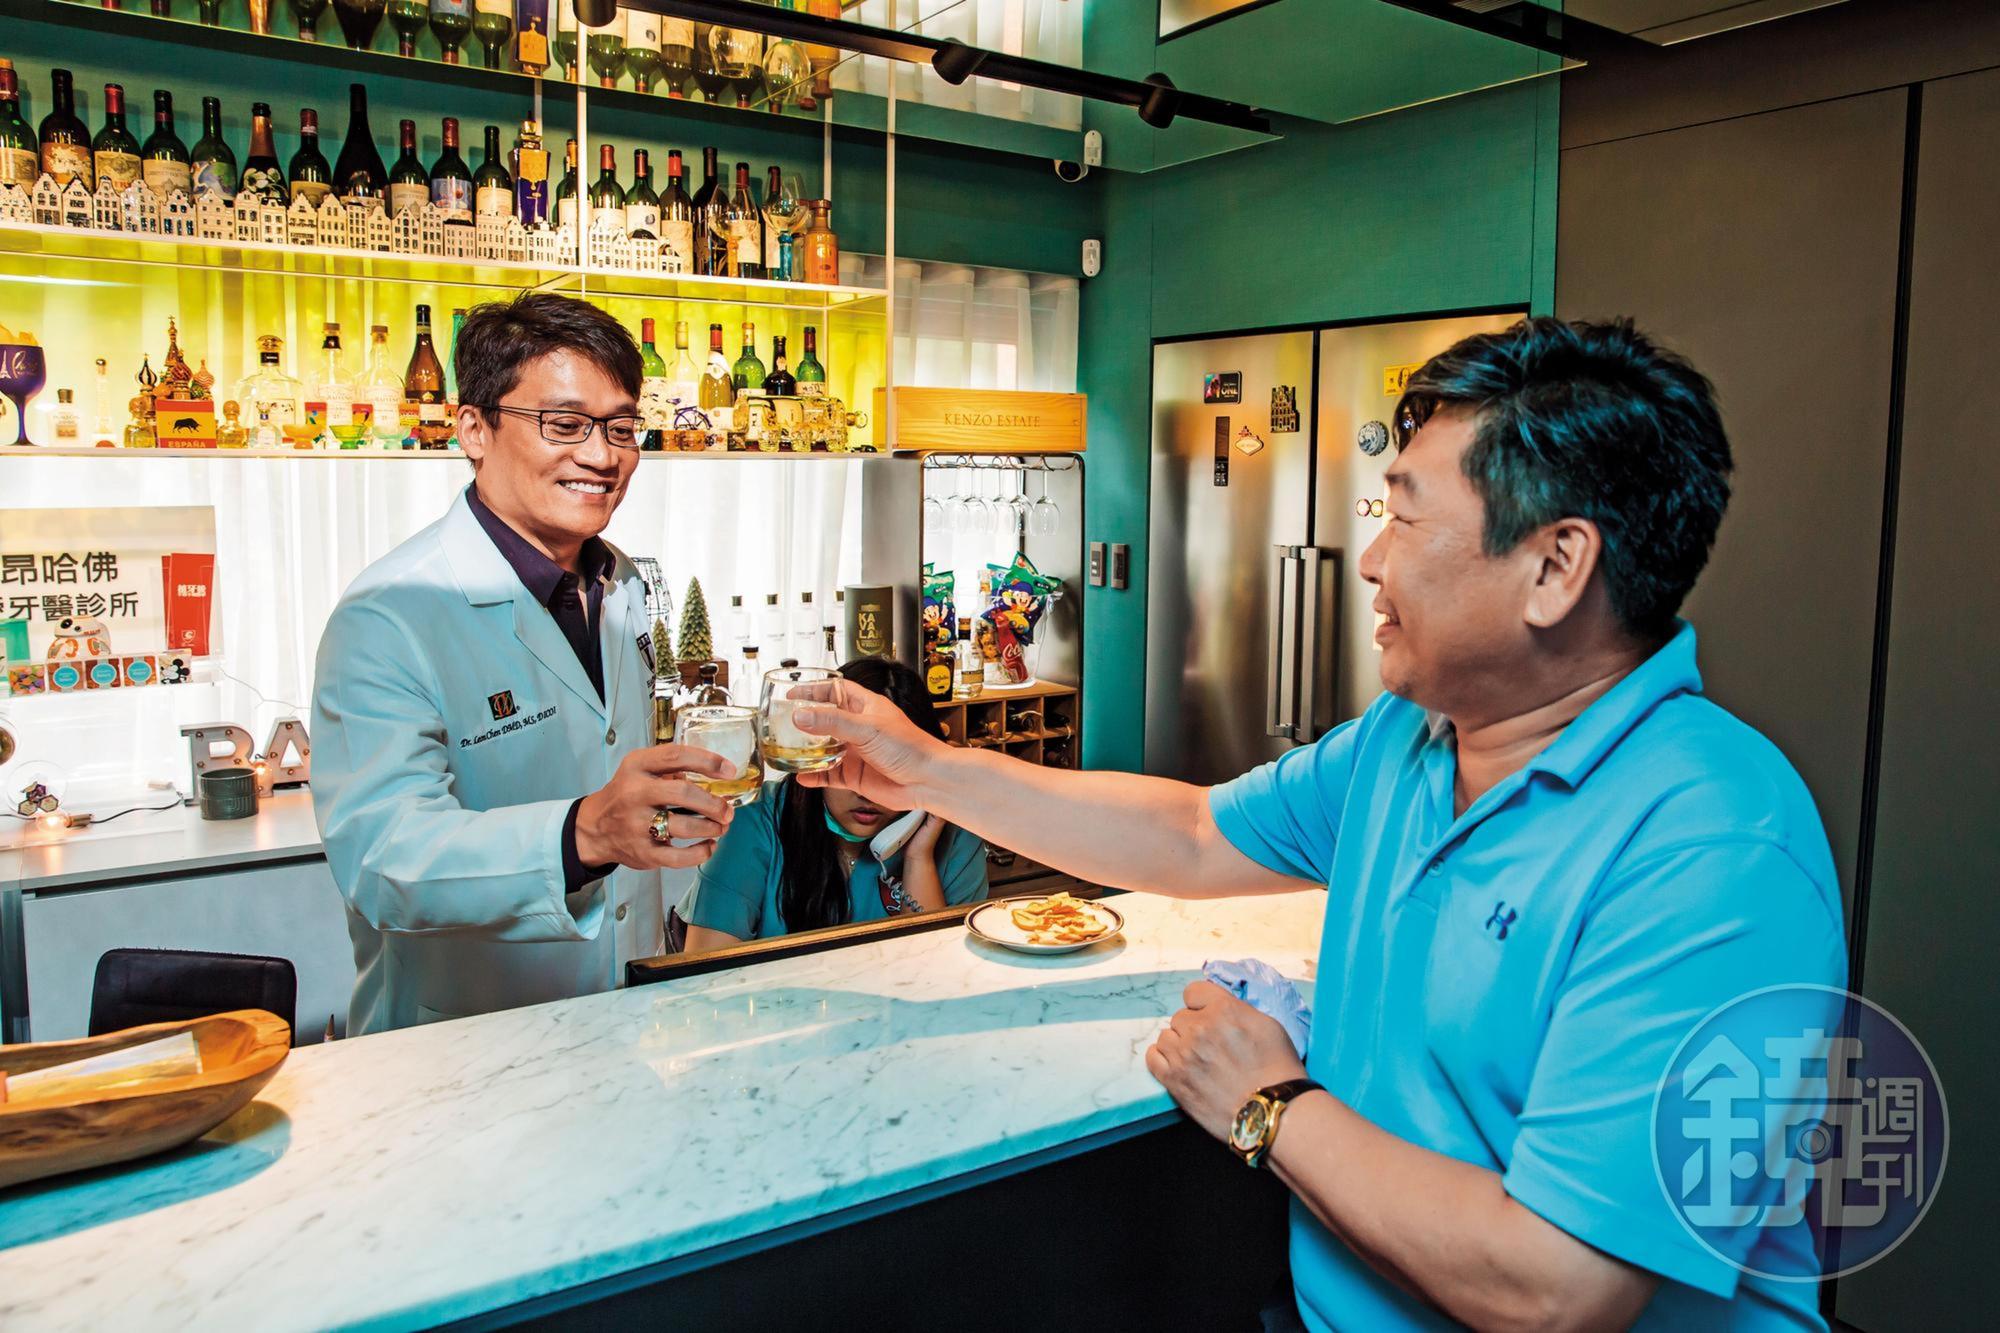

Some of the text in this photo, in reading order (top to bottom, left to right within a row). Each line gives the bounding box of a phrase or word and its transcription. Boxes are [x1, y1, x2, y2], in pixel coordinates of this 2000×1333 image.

[944, 413, 1041, 428] KENZO ESTATE
[167, 440, 206, 448] ESPAÑA
[1, 551, 118, 585] 昂哈佛
[0, 592, 139, 622] 牙醫診所
